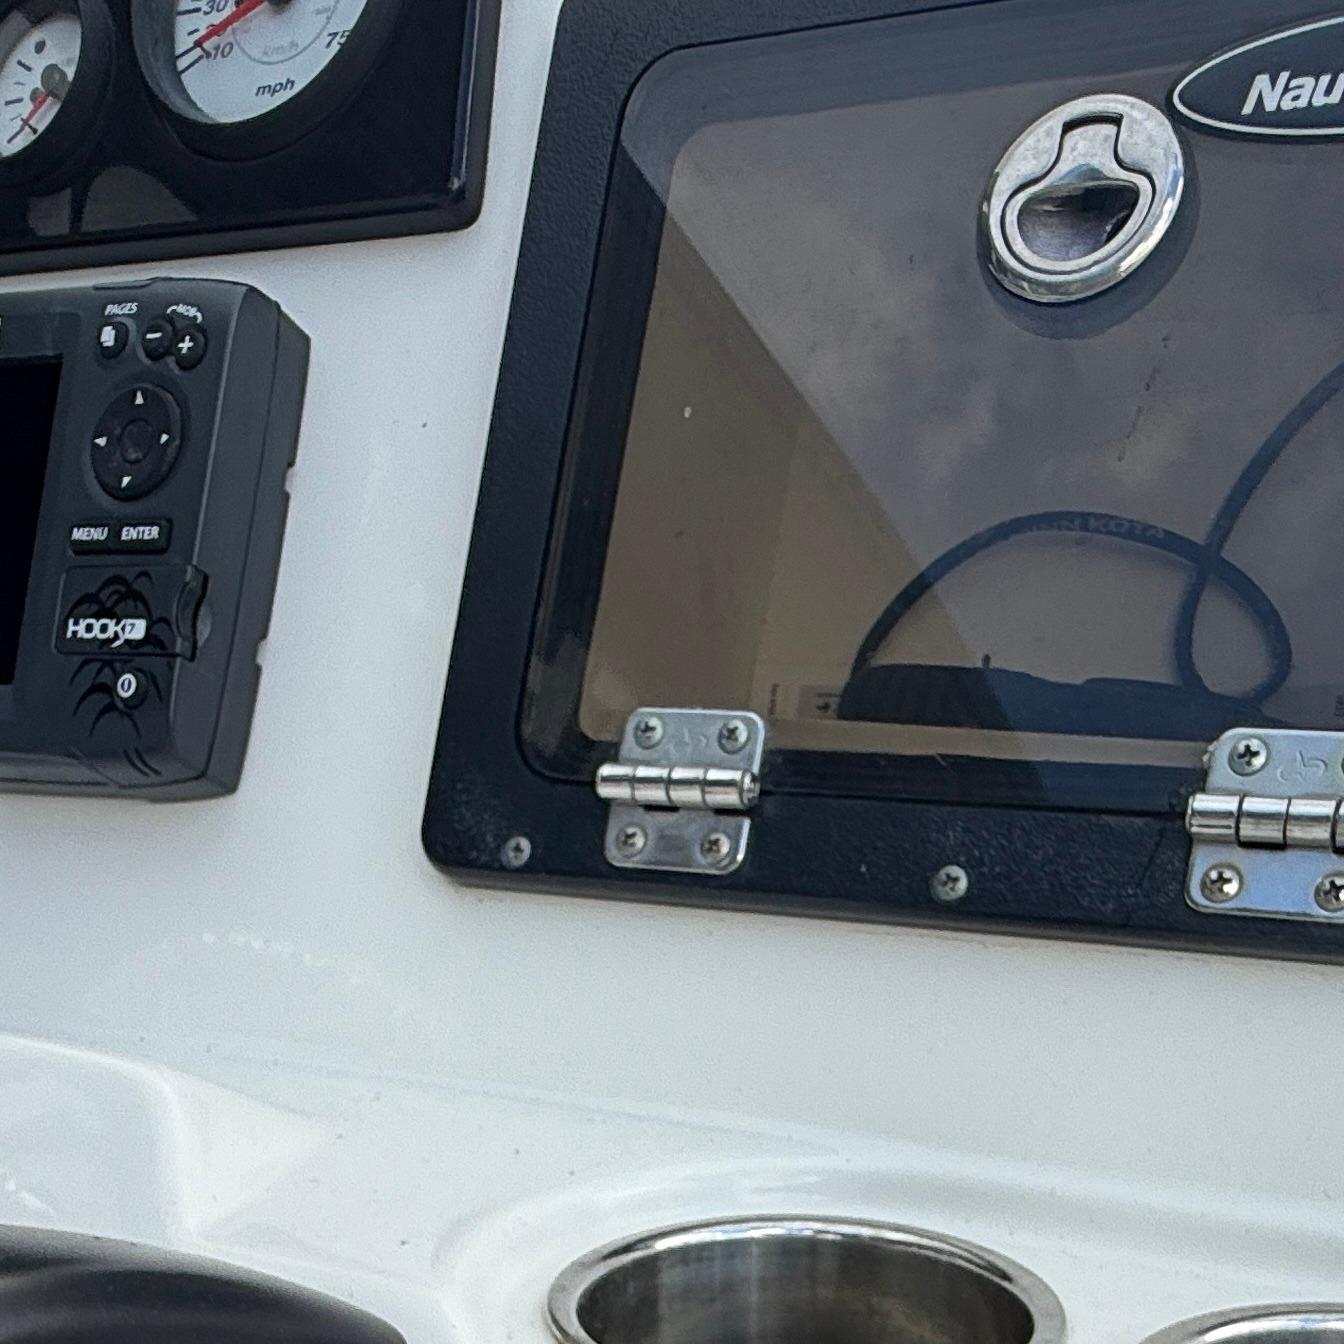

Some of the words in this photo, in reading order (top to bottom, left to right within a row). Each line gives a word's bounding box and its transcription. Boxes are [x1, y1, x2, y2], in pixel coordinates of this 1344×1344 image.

[256, 78, 296, 97] mph
[104, 303, 138, 316] PAGES
[71, 527, 108, 540] MENU
[121, 526, 159, 540] ENTER
